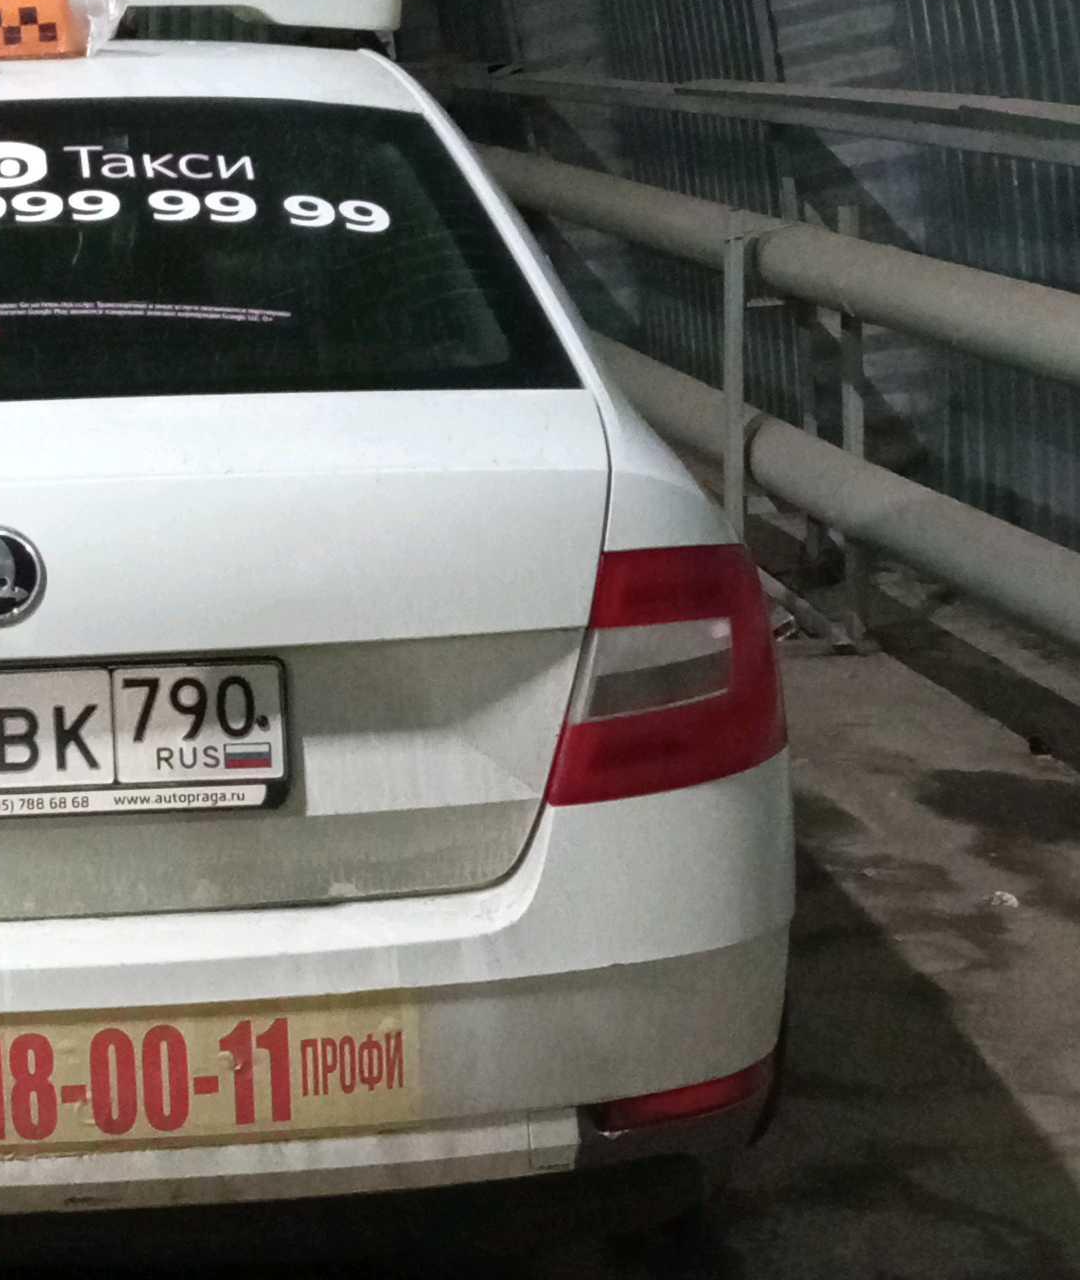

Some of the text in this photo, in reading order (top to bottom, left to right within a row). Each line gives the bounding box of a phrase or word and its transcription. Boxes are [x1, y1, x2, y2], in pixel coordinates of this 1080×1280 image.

[63, 145, 255, 181] Такси
[147, 190, 257, 222] 99
[283, 195, 391, 233] 99
[122, 675, 256, 742] 790
[157, 745, 220, 769] RUS
[19, 797, 44, 811] 788
[49, 796, 67, 810] 68
[71, 796, 89, 809] 68
[113, 790, 246, 806] www.autopraga.ru
[299, 1031, 405, 1096] ПРОФИ
